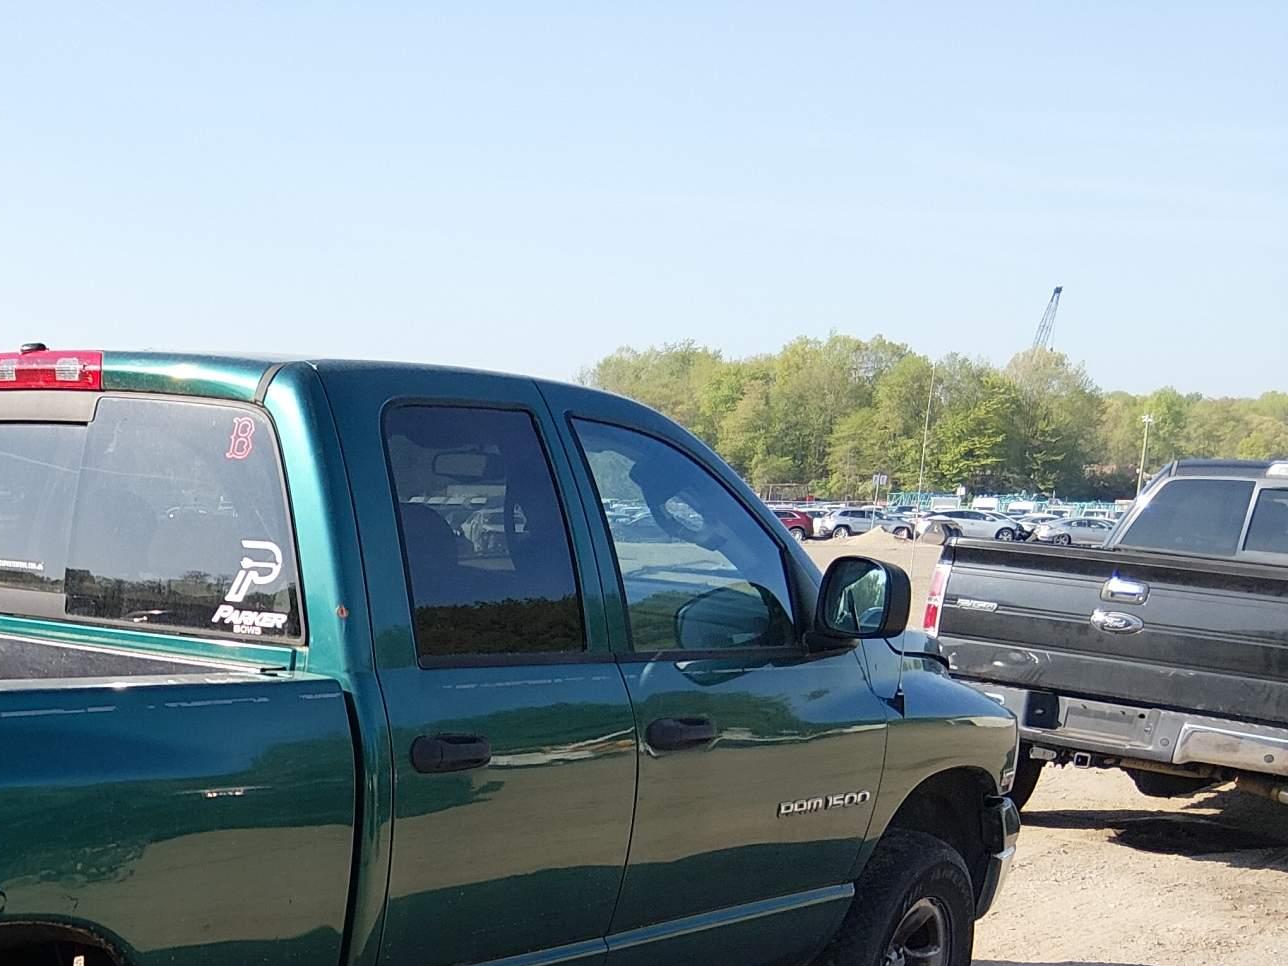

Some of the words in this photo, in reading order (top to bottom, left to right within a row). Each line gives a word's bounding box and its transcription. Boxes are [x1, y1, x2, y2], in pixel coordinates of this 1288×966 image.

[225, 416, 256, 460] B
[211, 603, 288, 629] PARKER
[233, 624, 262, 635] BOWS
[824, 790, 871, 810] 1500
